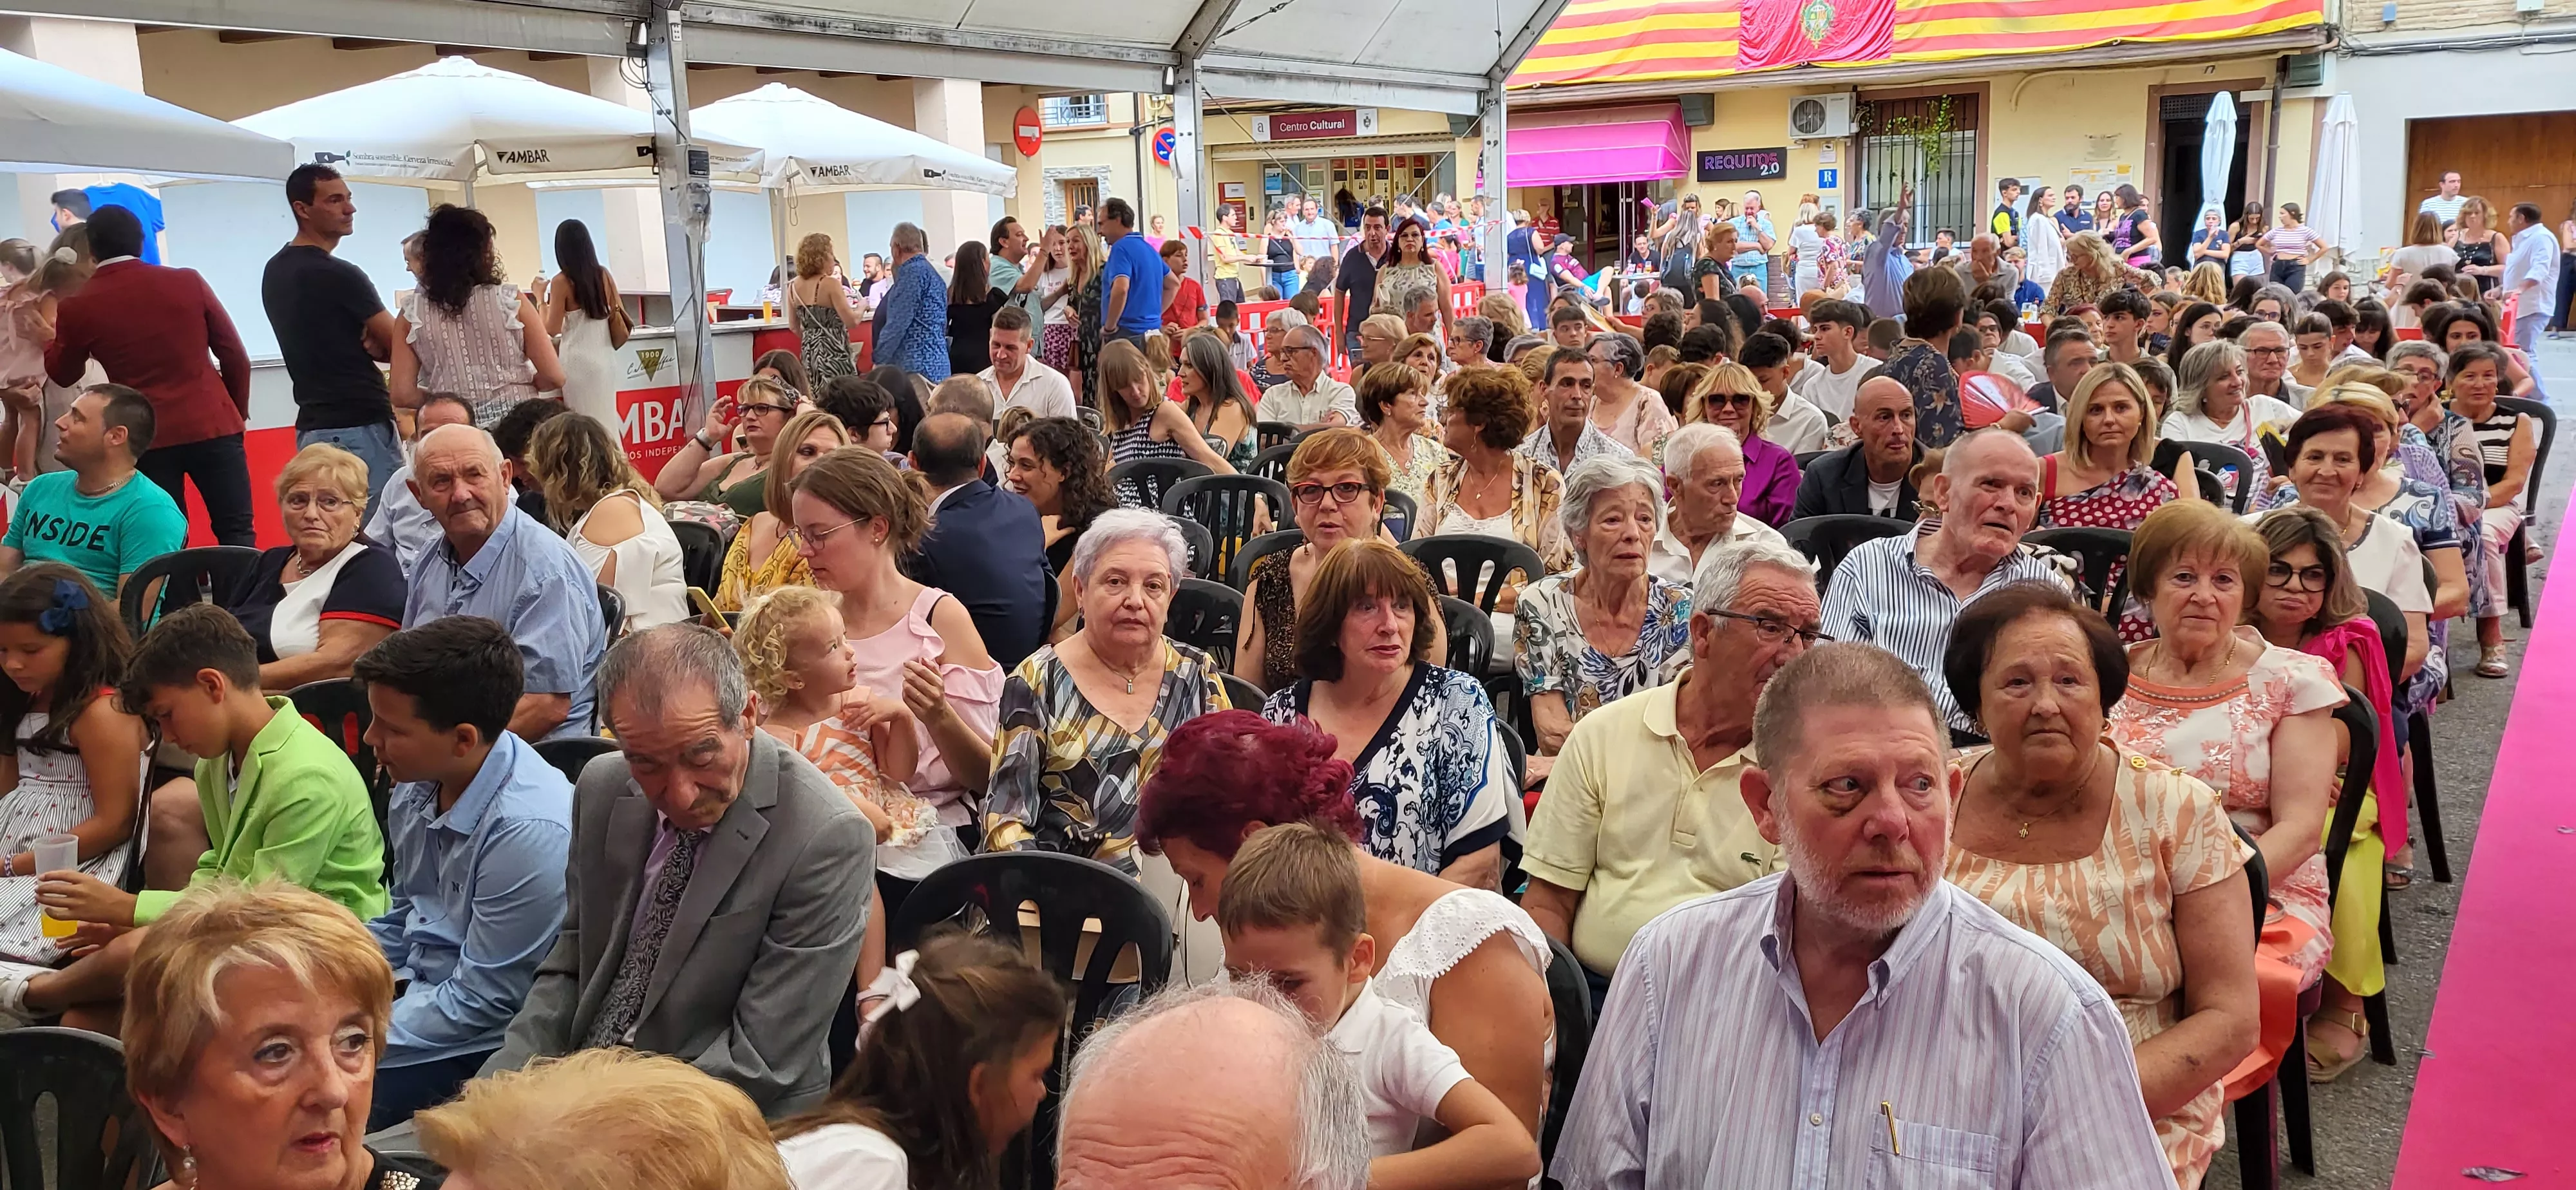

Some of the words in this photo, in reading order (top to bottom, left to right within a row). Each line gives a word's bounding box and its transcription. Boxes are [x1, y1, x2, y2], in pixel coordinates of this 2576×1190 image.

[1280, 122, 1308, 132] Centro
[1309, 118, 1345, 130] Cultural
[506, 149, 551, 164] AMBAR
[1705, 152, 1778, 170] REQUITOS
[818, 165, 851, 178] AMBAR
[1759, 162, 1780, 176] 2.0
[1823, 171, 1833, 182] R
[616, 397, 685, 444] MBA
[629, 450, 642, 460] OS
[23, 508, 111, 552] INSIDE
